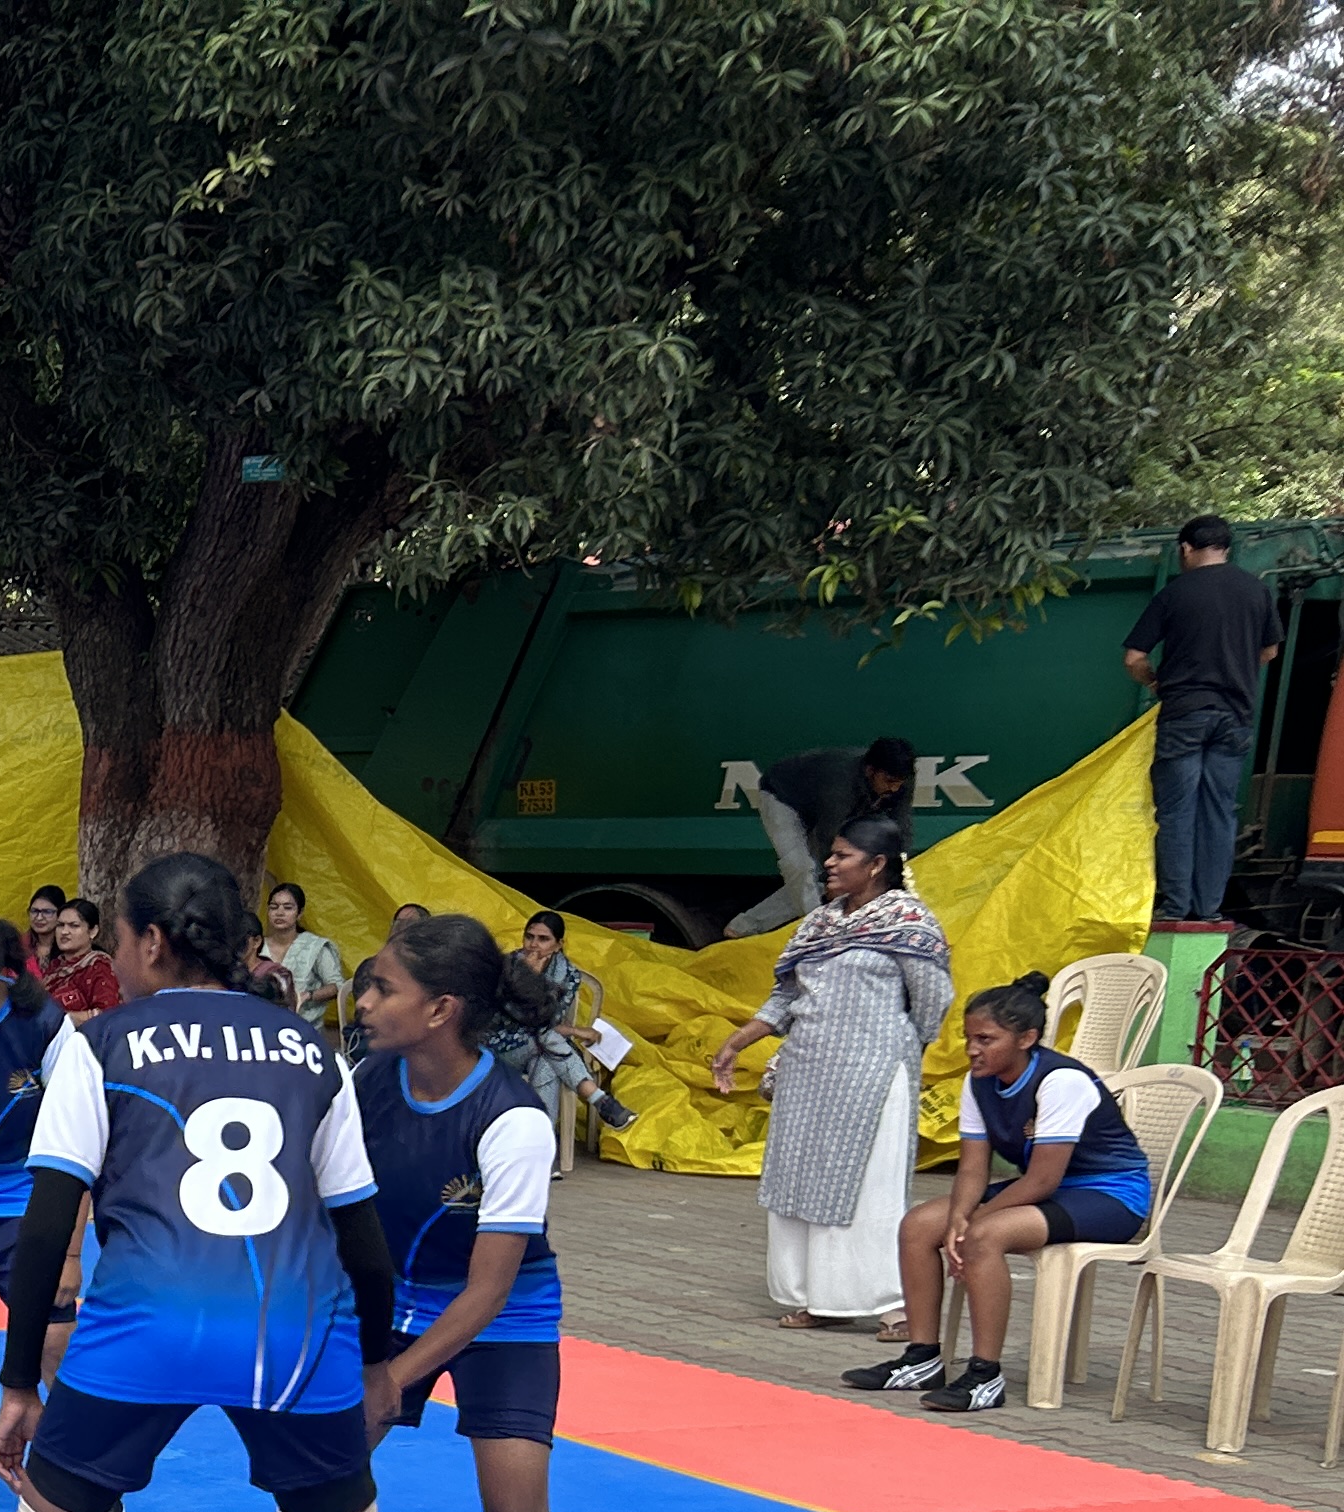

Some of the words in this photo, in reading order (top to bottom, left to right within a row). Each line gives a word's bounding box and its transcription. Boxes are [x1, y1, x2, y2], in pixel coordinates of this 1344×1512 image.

[126, 1023, 213, 1070] K.V.
[222, 1025, 324, 1075] I.I.Sc
[179, 1096, 289, 1236] 8
